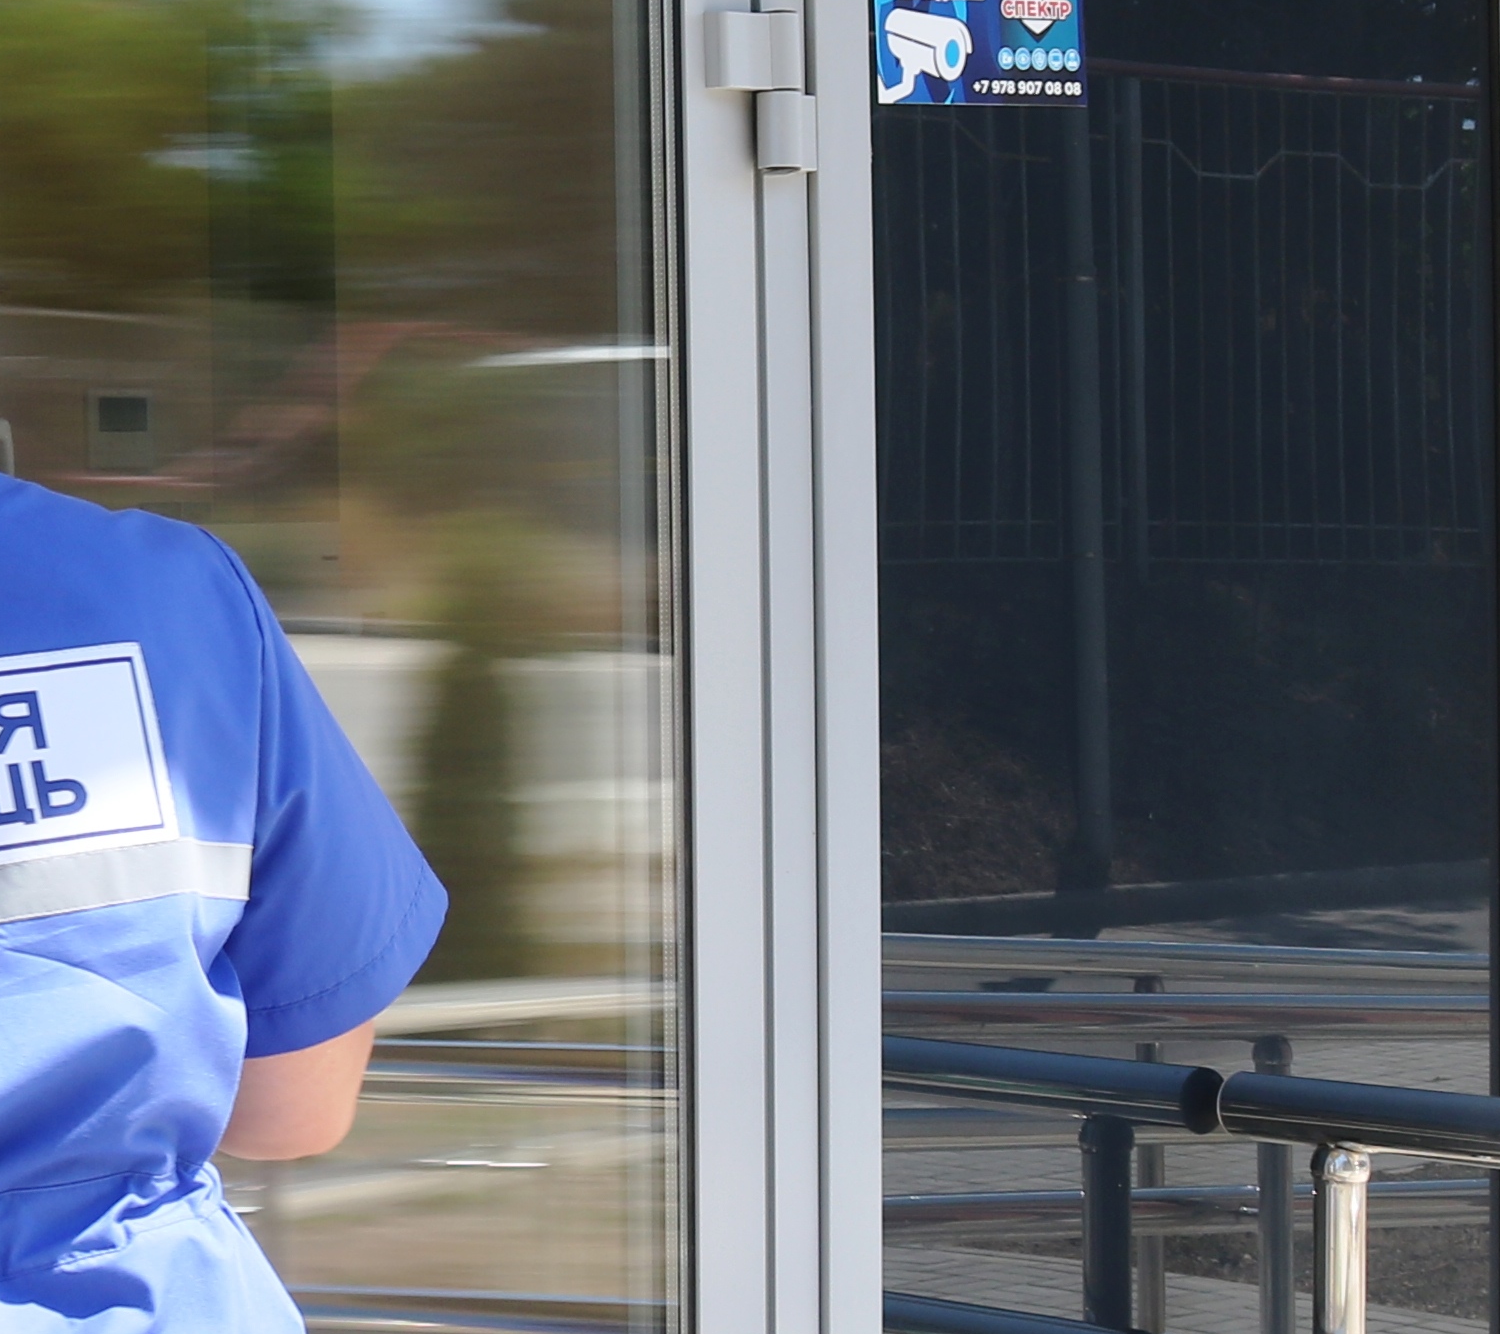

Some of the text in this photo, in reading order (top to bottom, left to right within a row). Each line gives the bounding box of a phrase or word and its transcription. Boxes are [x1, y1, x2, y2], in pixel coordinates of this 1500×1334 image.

[1002, 0, 1070, 18] СПЕКТР
[973, 80, 1082, 96] +7 978 907 08 08
